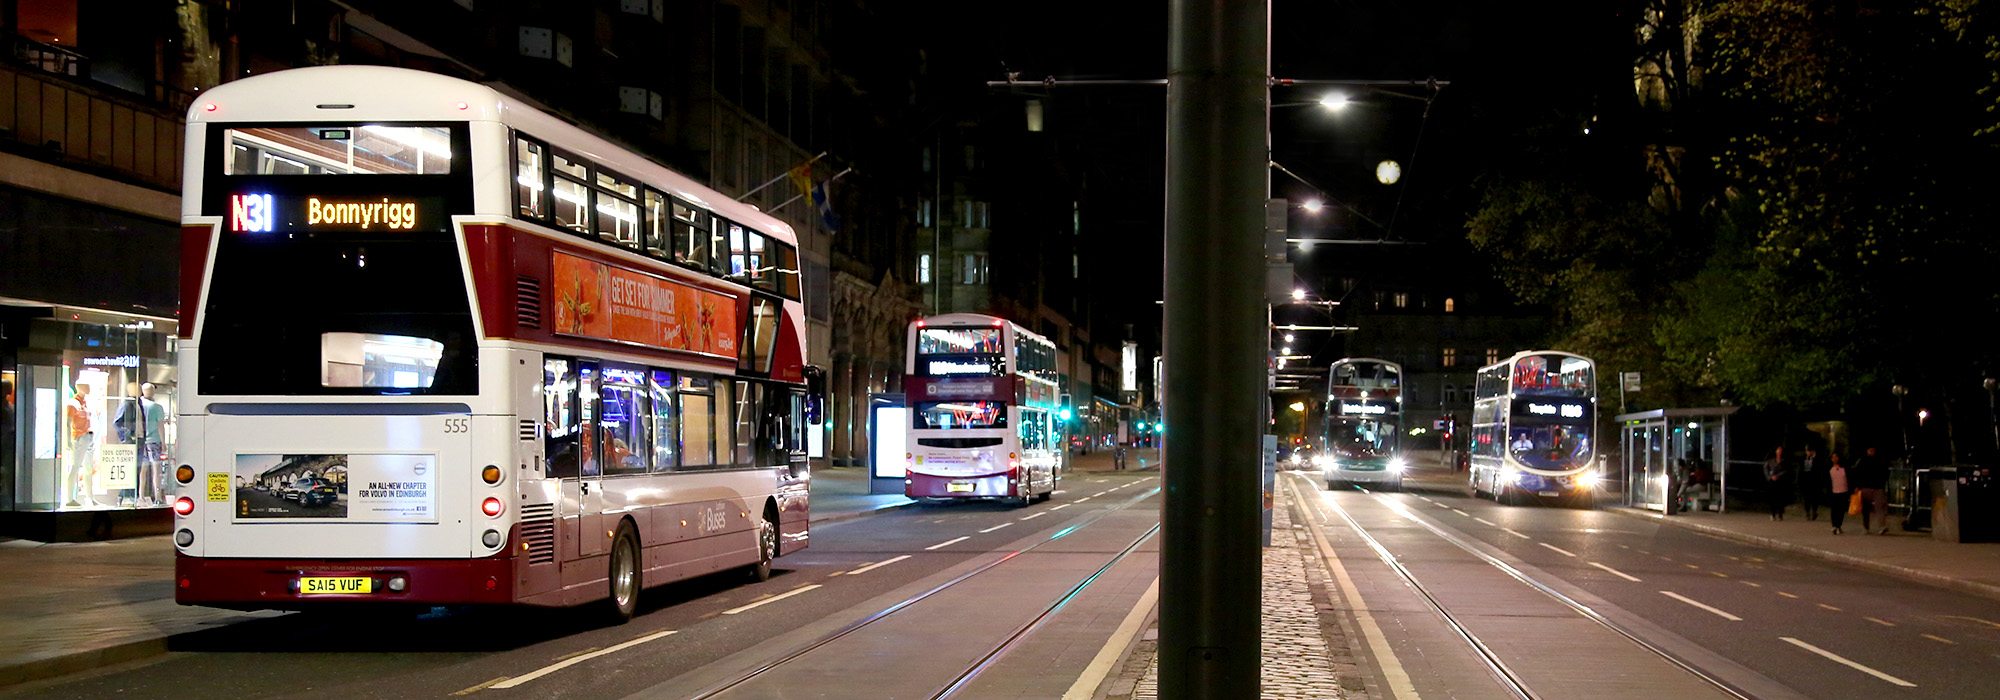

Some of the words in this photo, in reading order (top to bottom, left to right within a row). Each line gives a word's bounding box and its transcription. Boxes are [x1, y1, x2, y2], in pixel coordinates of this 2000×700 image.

[233, 194, 272, 232] N31
[308, 197, 416, 229] Bonnyrigg
[612, 276, 624, 304] GET
[625, 279, 637, 306] SET
[638, 282, 651, 309] FOR
[651, 285, 675, 315] SUMMER
[444, 418, 469, 433] 555
[110, 465, 126, 480] £15
[369, 482, 377, 490] AN
[378, 482, 402, 490] ALL-NEW
[402, 482, 427, 490] CHAPTER
[359, 490, 369, 498] FOR
[370, 490, 388, 498] VOLVO
[388, 490, 395, 498] IN
[395, 490, 427, 498] EDINBURGH
[706, 507, 726, 531] Buses
[308, 579, 336, 591] SA15
[340, 579, 364, 591] VUF
